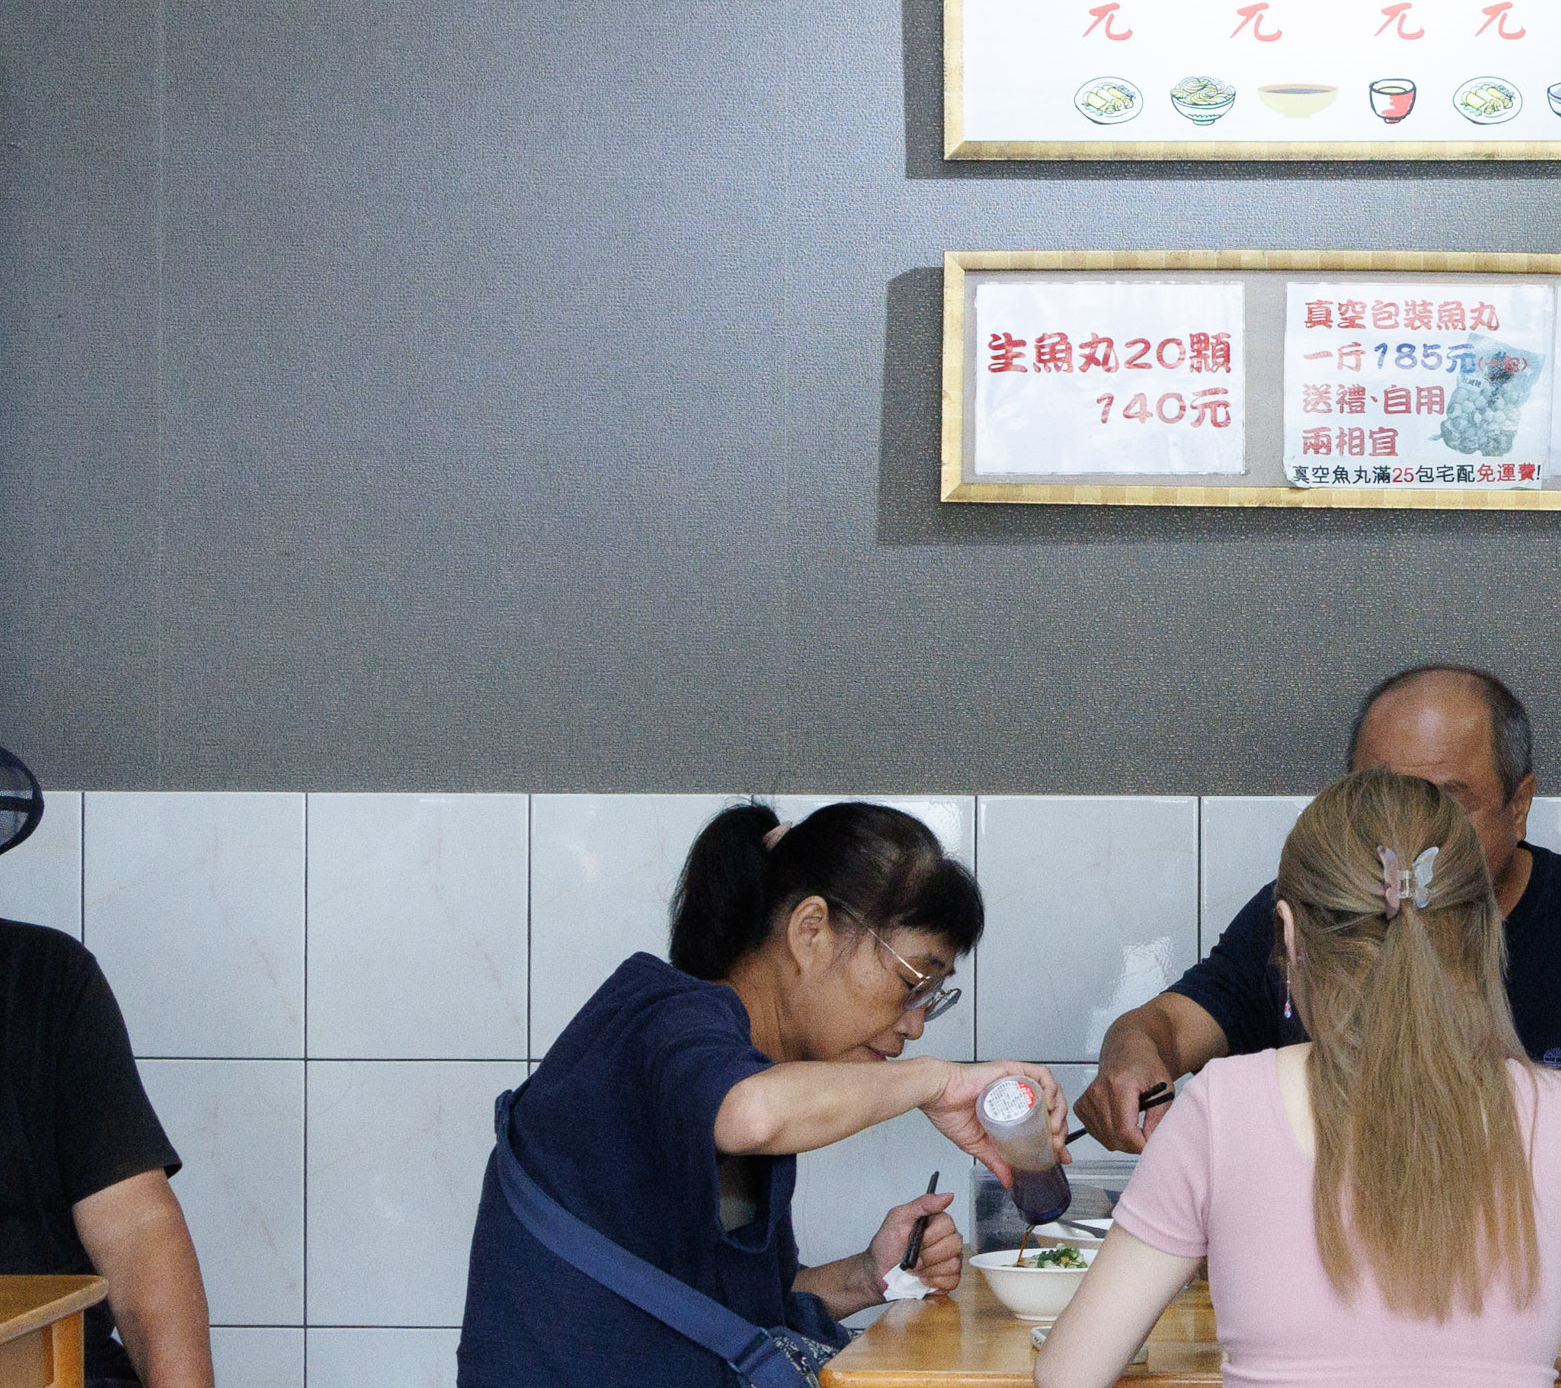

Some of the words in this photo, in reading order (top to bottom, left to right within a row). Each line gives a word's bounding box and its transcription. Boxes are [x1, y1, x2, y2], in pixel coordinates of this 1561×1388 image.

[1304, 299, 1500, 331] 真空包裝魚丸
[987, 332, 1232, 374] 生魚丸20顆
[1096, 387, 1232, 428] 140元
[1302, 426, 1399, 457] 兩相宜
